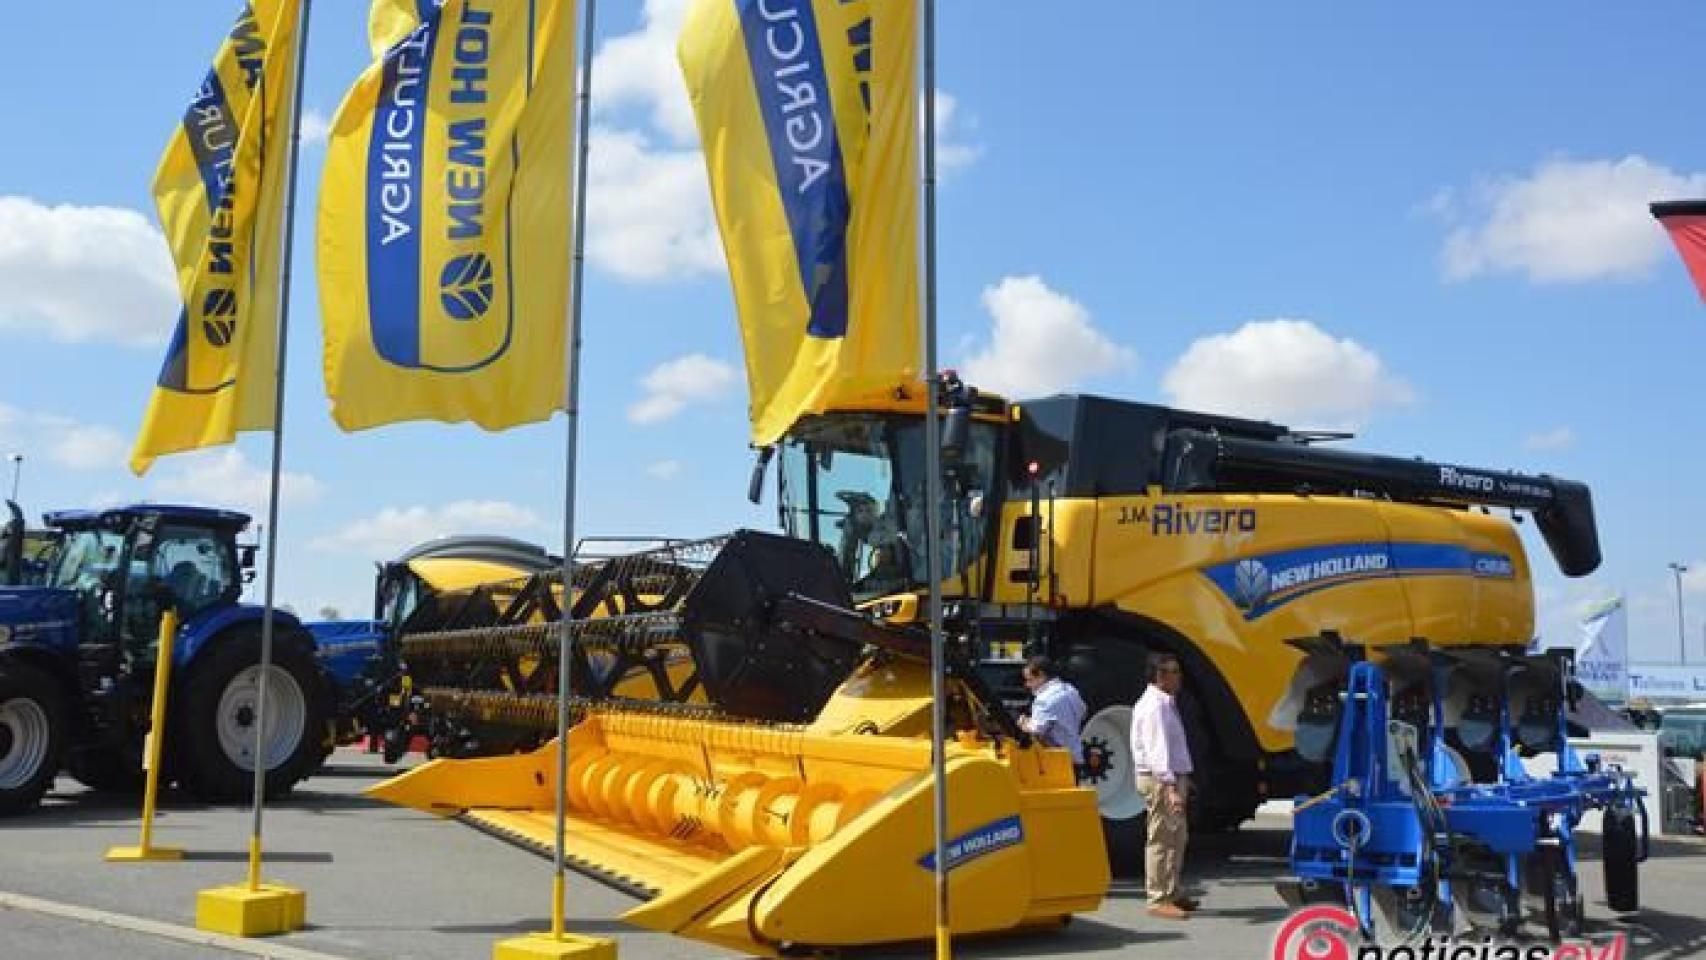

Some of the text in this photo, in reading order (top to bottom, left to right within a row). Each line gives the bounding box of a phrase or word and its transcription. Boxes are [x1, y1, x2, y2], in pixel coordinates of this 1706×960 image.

[1439, 467, 1494, 491] Rivero
[1152, 502, 1256, 535] Rivero
[1271, 553, 1388, 591] NEW HOLLAND
[962, 826, 1019, 856] HOLLAND
